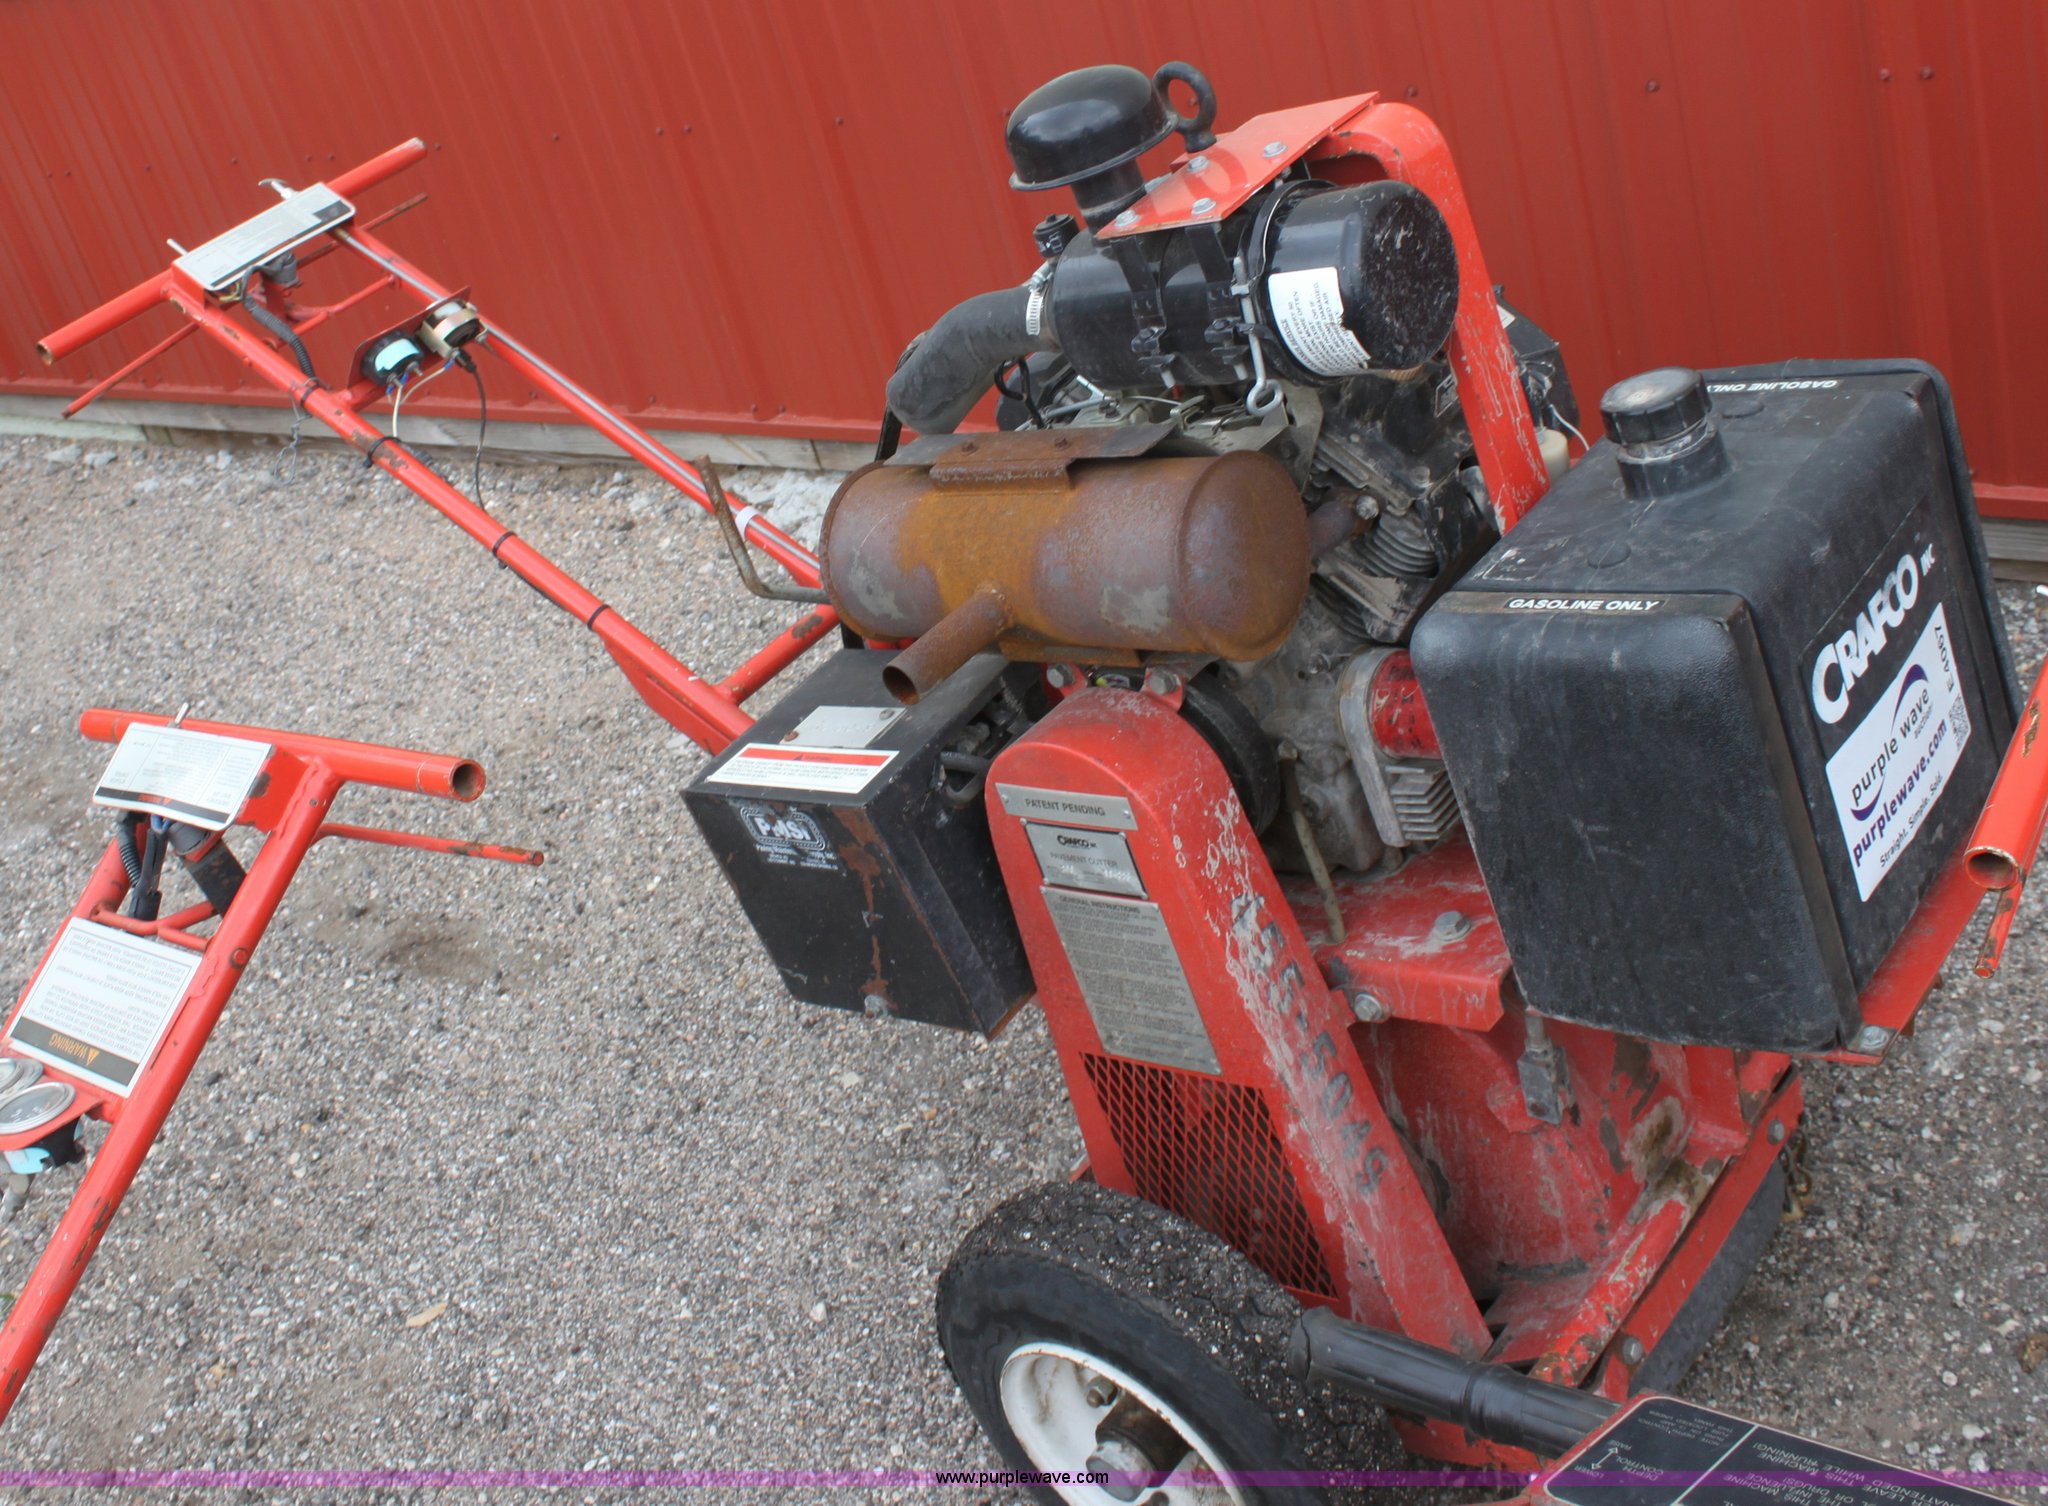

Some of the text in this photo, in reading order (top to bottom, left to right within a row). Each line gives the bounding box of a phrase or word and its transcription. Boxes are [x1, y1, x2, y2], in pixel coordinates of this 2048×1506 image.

[1747, 380, 1838, 392] GASOLINE
[1508, 599, 1660, 611] GASOLINE ONLY
[1812, 553, 1918, 724] CRAFCO
[1851, 688, 1930, 807] purple wave
[1852, 719, 1948, 868] purplewave.com
[1025, 798, 1106, 816] PATENT PENDING
[1880, 827, 1908, 868] Straight.
[1050, 852, 1119, 868] PAVEMENT CUTTER
[1059, 895, 1142, 913] GENERAL INSTRUCTIONS
[49, 1033, 88, 1059] WARNING
[1574, 1465, 1605, 1479] LOWER
[1616, 1456, 1664, 1475] CONTROL
[1622, 1466, 1658, 1482] DEPTH
[1752, 1442, 1961, 1506] NATTENDED WHILE RUNNING!
[1757, 1452, 1820, 1476] MACHINE
[1723, 1473, 1811, 1506] THIS MACHINE
[1749, 1472, 1813, 1499] INFLUENCE
[1783, 1477, 1854, 1503] OR DRUGS!
[1825, 1472, 1855, 1487] THIS
[1862, 1485, 1906, 1502] LEAVE
